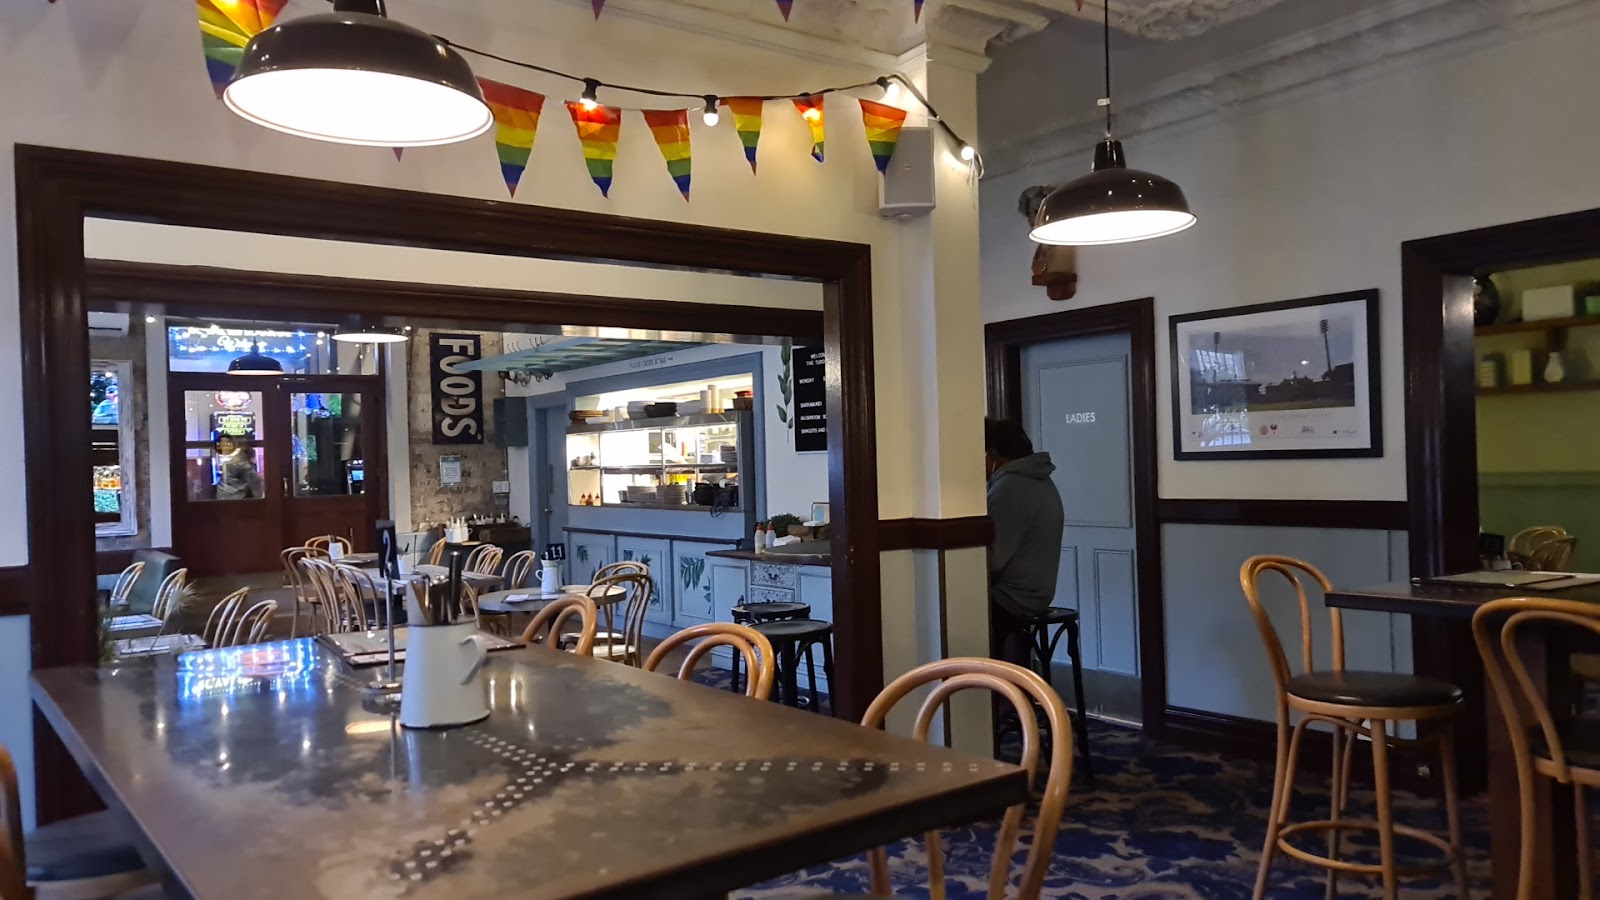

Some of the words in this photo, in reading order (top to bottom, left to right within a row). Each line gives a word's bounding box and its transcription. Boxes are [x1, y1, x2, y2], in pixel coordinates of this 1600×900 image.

[438, 338, 478, 437] FOODS
[1065, 411, 1096, 424] LADIES
[550, 545, 562, 558] 11
